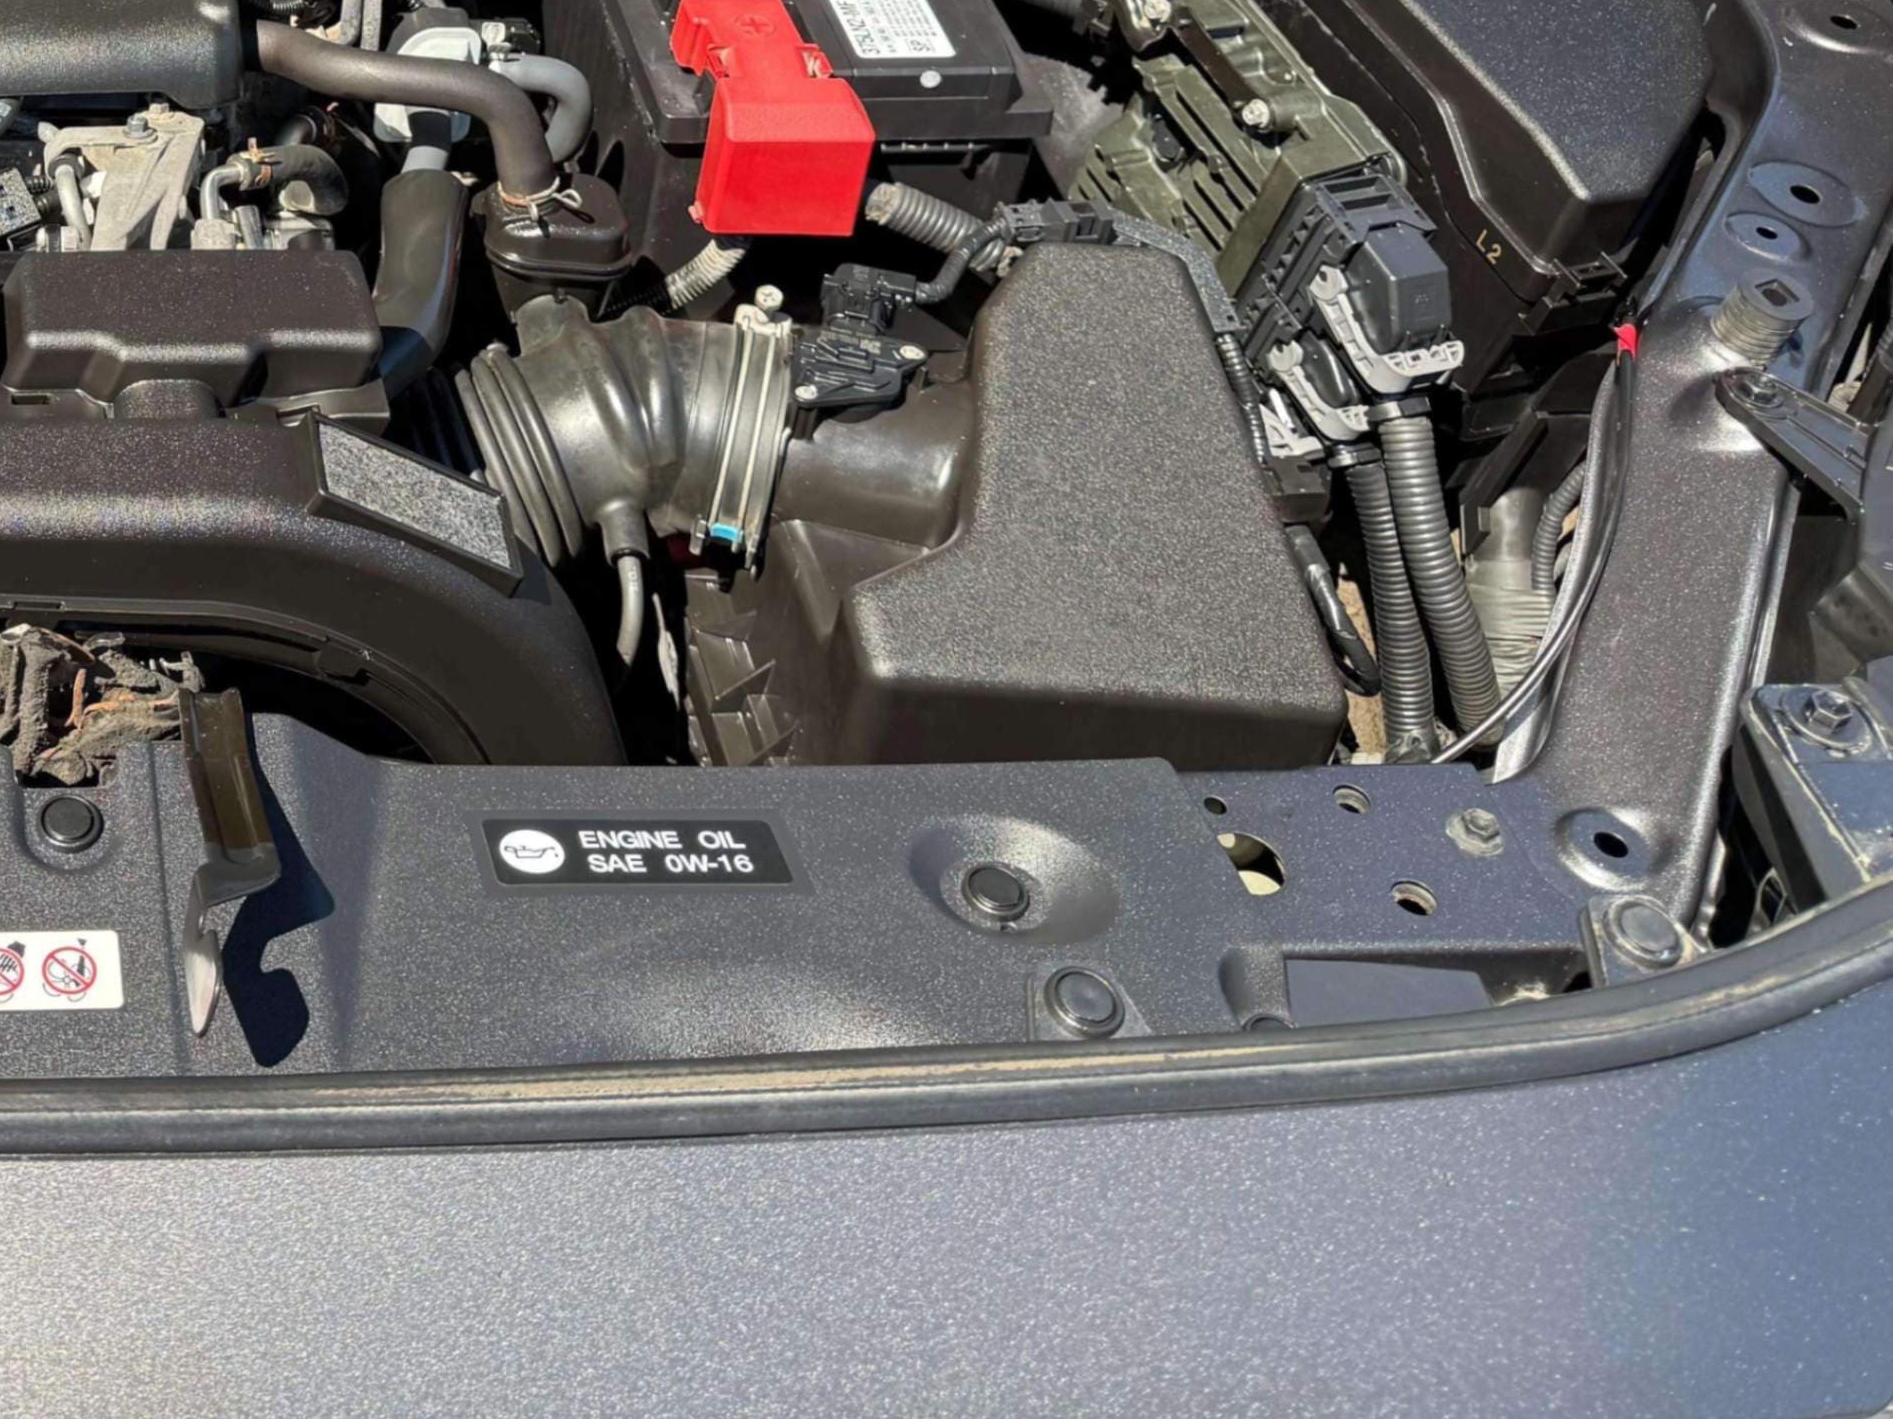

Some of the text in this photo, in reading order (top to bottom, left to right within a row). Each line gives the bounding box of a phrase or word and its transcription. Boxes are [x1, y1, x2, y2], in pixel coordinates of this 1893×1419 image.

[1476, 229, 1501, 265] L2
[578, 830, 747, 850] ENGINE OIL
[587, 853, 755, 873] SAE 0W-16
